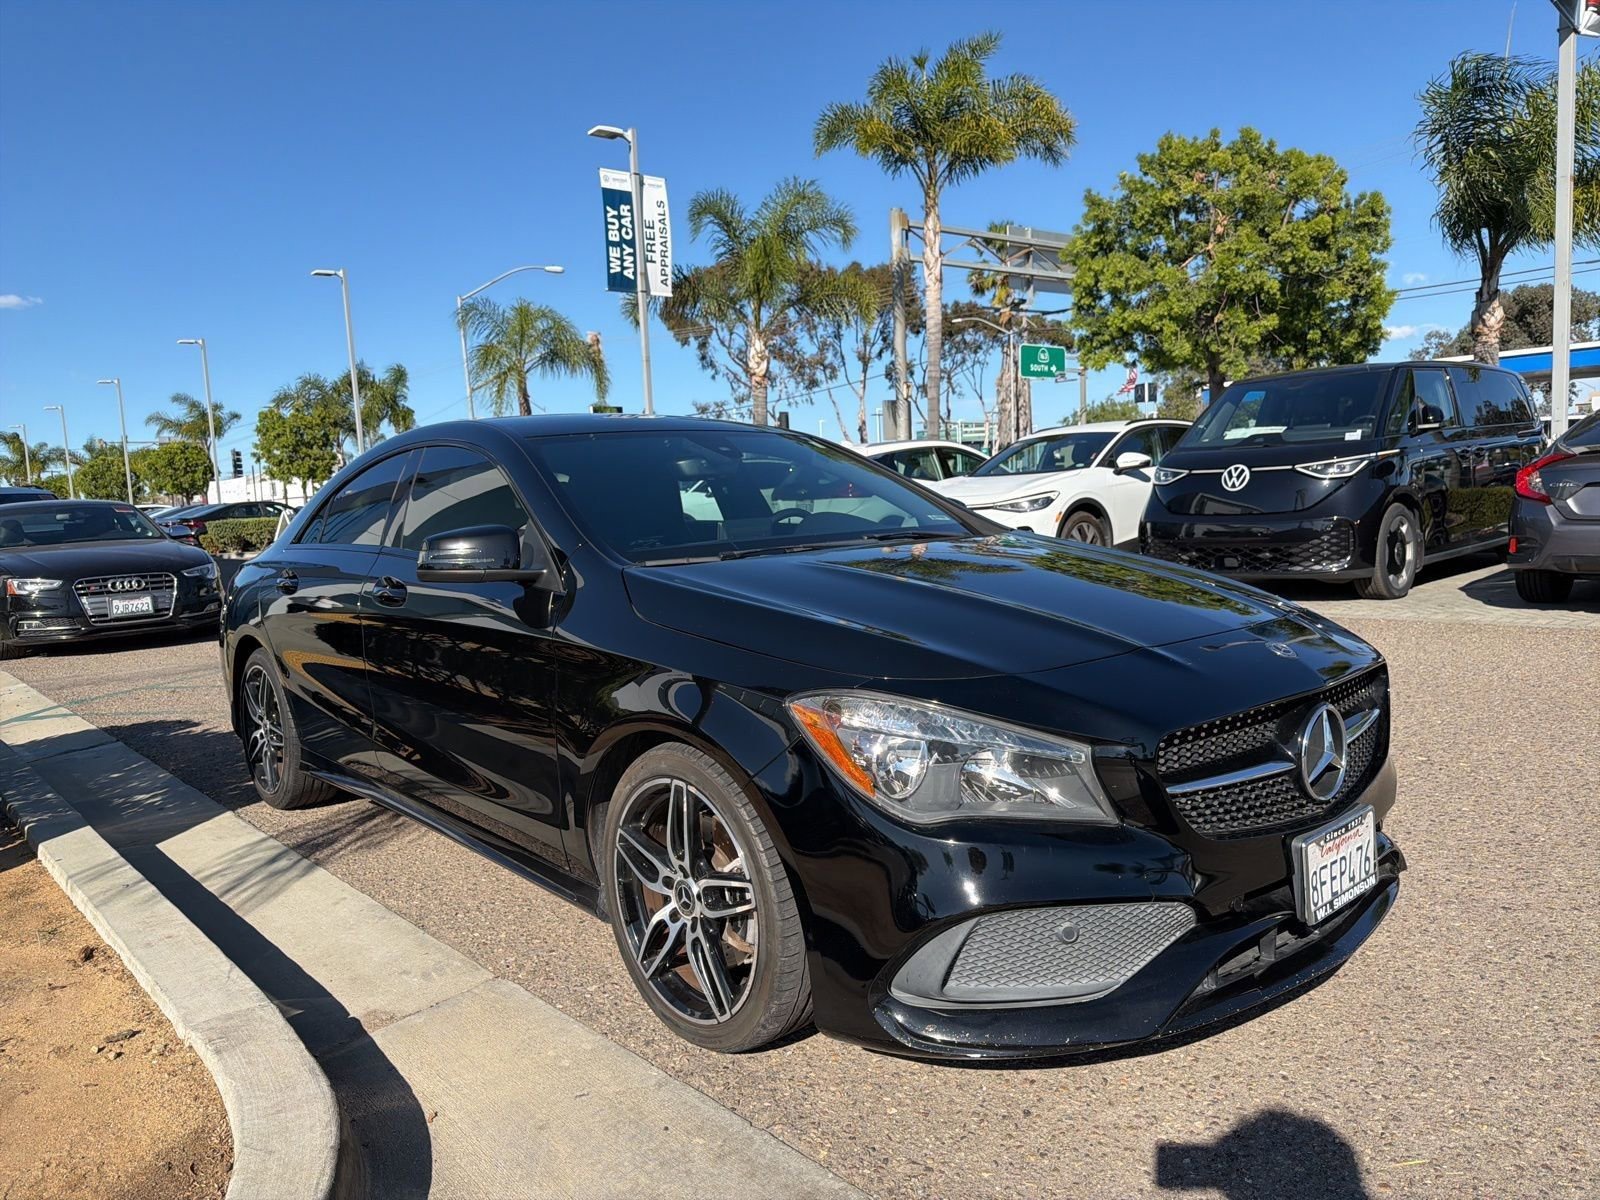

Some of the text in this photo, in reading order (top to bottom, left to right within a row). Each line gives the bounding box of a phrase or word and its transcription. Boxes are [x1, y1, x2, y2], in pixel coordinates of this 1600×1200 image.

[606, 205, 621, 274] WE BUY
[620, 204, 635, 280] ANY CAR
[644, 219, 657, 264] FREE
[656, 200, 669, 287] APPRAISALS
[1030, 363, 1049, 372] SOUTH
[114, 602, 150, 615] 9JRZ623
[1325, 827, 1346, 842] Since
[1311, 838, 1371, 908] 8FEP476
[1333, 874, 1376, 909] SIMONSON
